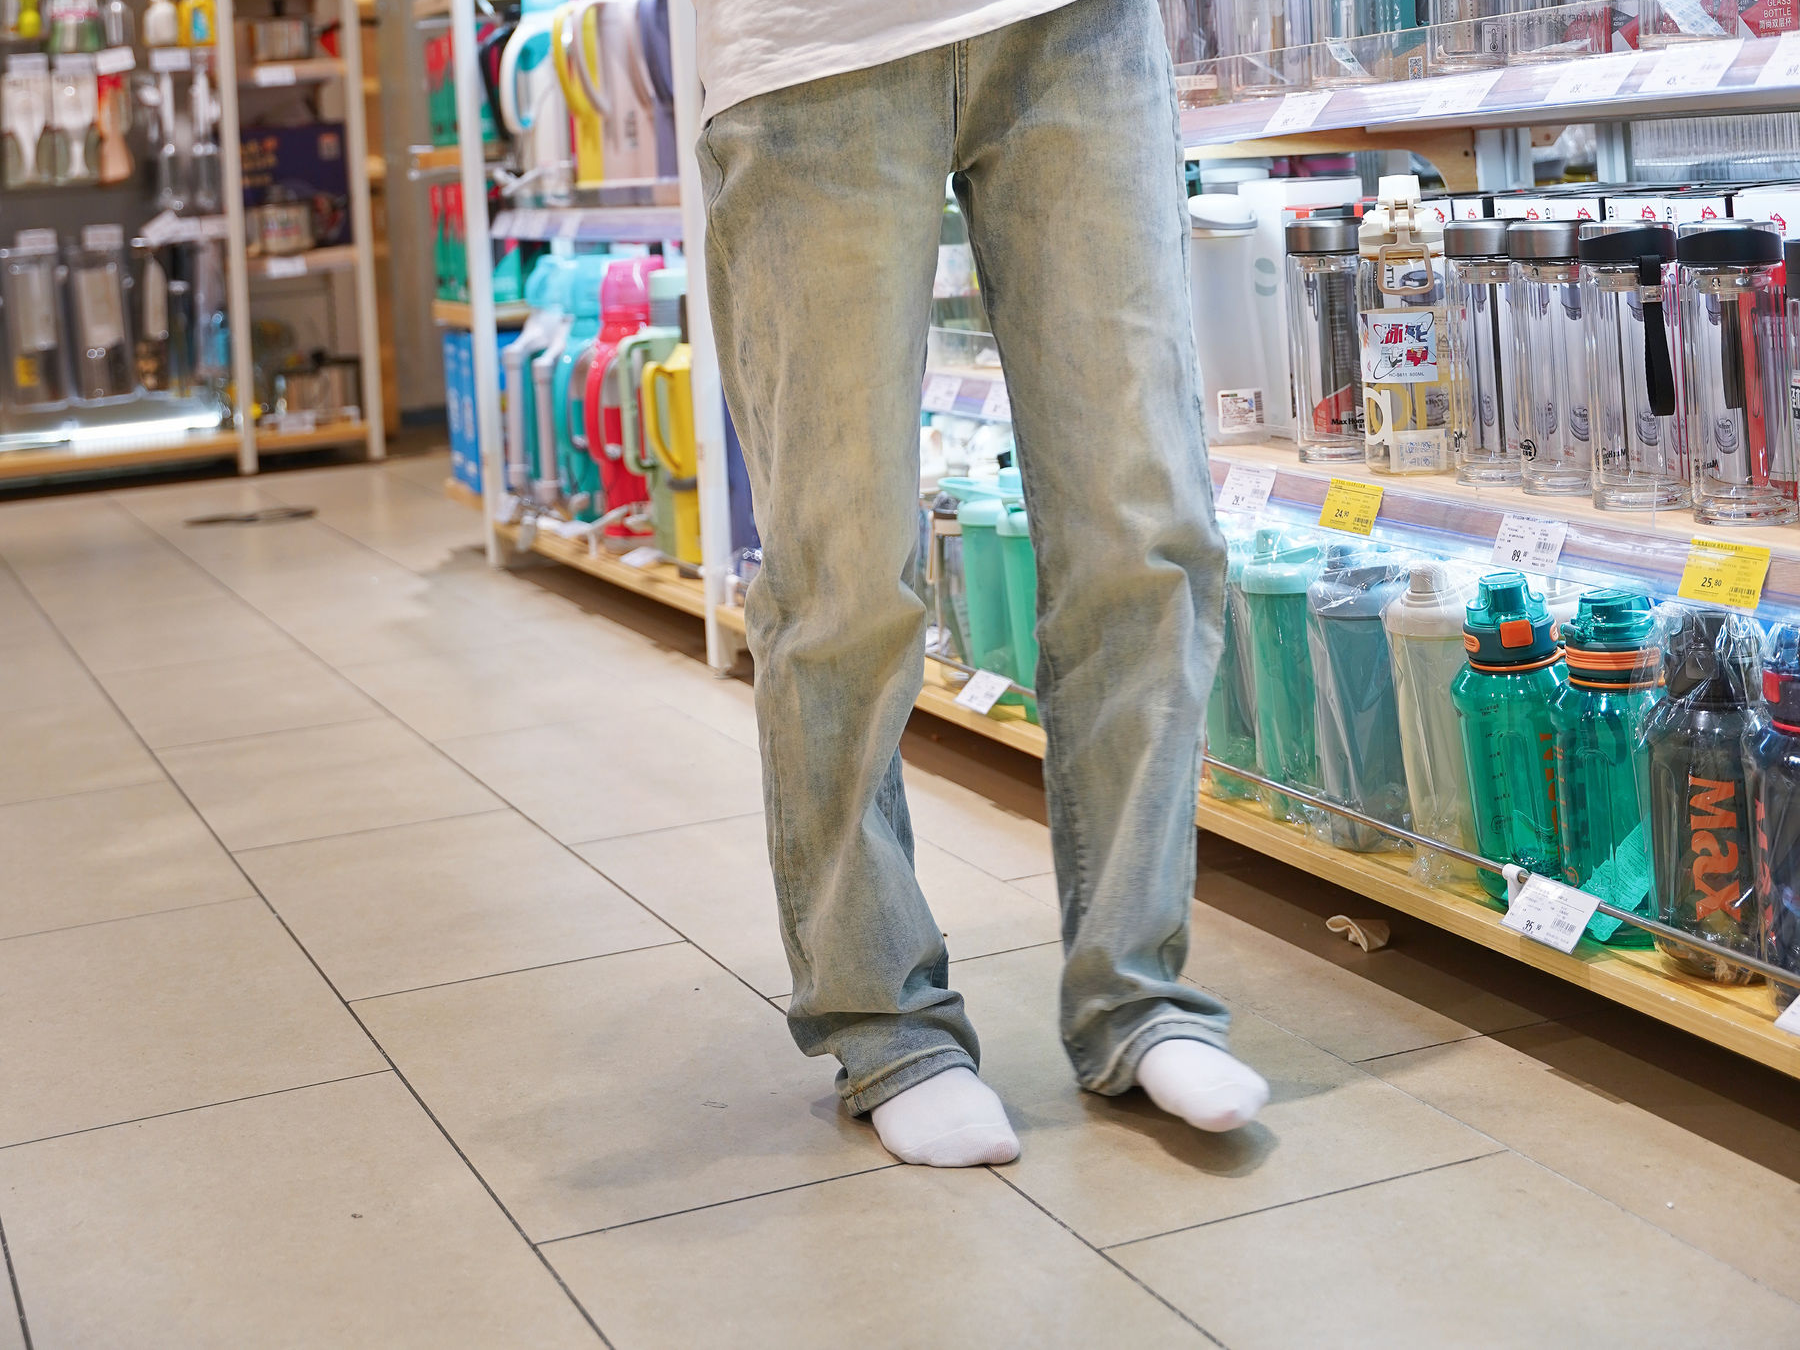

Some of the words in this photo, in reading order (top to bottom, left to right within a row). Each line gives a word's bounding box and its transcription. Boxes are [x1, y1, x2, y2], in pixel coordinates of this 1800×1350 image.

[1764, 7, 1791, 18] BOTTLE
[1331, 417, 1348, 426] Max
[1348, 417, 1364, 426] Hom
[1688, 773, 1741, 922] Max
